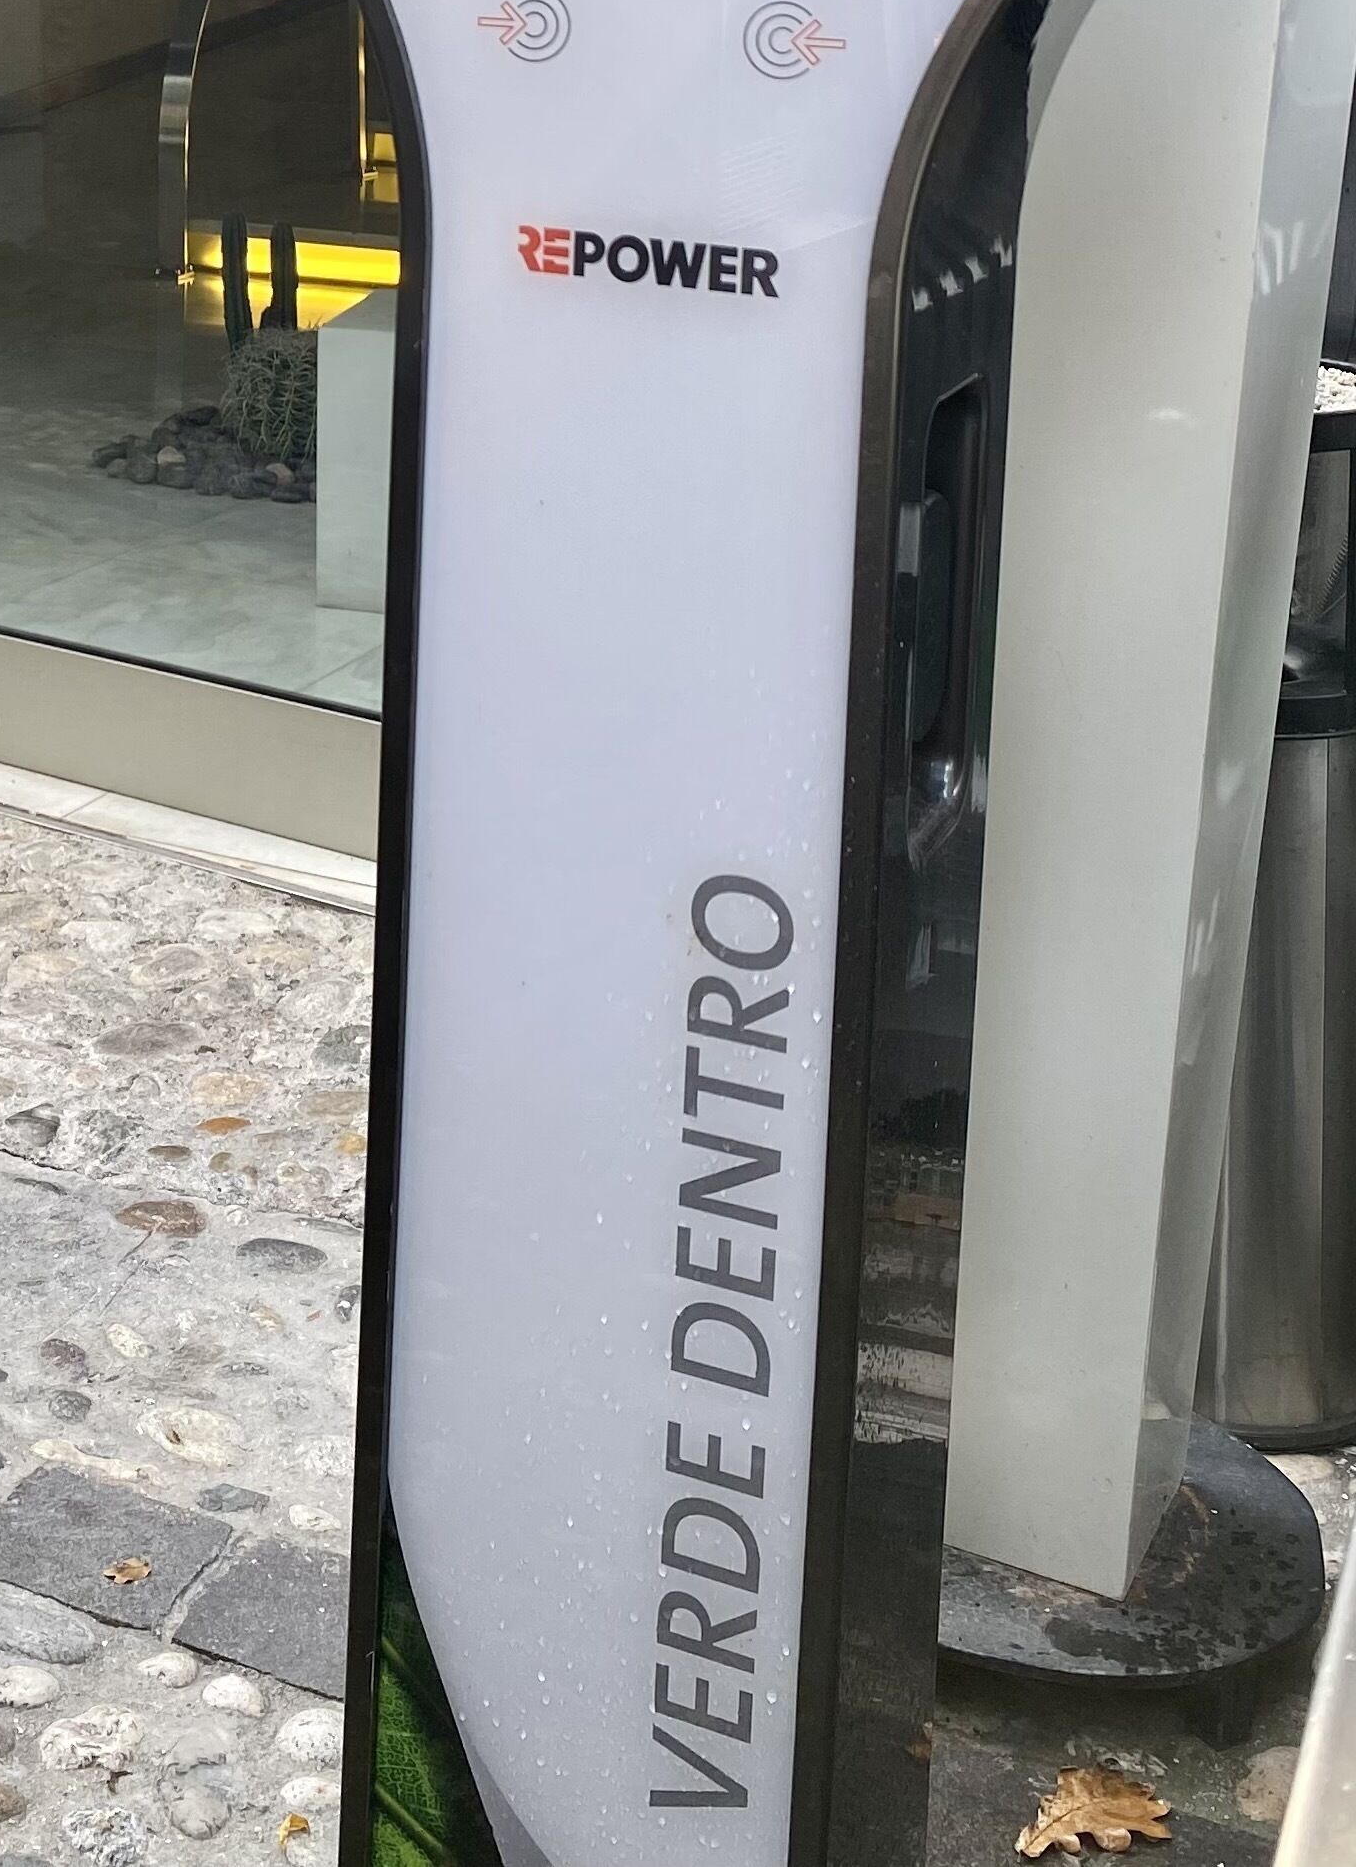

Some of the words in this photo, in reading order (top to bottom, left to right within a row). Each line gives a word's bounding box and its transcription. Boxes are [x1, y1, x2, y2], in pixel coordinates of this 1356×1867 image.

[517, 224, 780, 299] REPOWER
[669, 873, 795, 1398] DENTRO
[648, 1419, 769, 1810] VERDE
